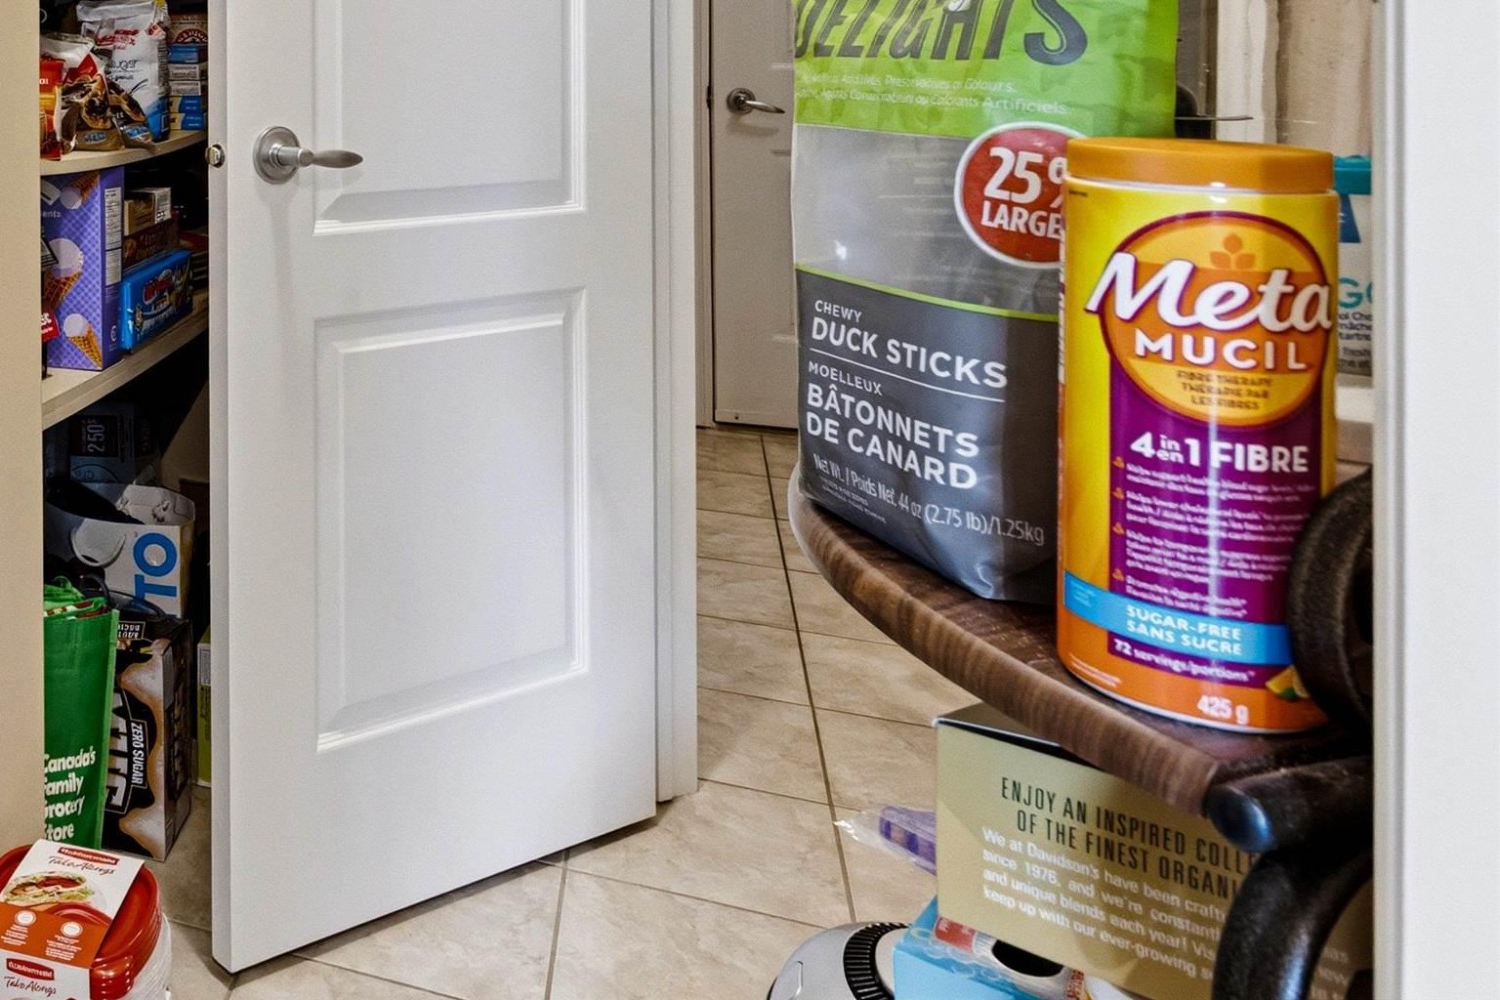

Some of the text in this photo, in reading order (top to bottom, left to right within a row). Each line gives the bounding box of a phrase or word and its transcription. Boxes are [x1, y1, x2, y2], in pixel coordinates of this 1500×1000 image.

[814, 299, 862, 323] CHEWY
[1084, 250, 1334, 332] Meta
[811, 316, 1008, 389] DUCK STICKS
[1134, 328, 1308, 370] MUCIL
[808, 360, 883, 396] MOELLEUX
[1176, 370, 1275, 387] FIBRE THERAPY
[806, 383, 980, 459] BÂTONNETS
[1190, 395, 1260, 411] LES FIBRES
[806, 411, 978, 490] DE CANARD
[1130, 431, 1309, 473] 4 in 1 FIBRE
[1156, 448, 1184, 464] en
[851, 470, 877, 498] Poids
[911, 501, 922, 519] oz
[924, 502, 962, 528] (2.75
[1126, 604, 1243, 641] SUGAR-FREE
[1126, 620, 1243, 656] SANS SUCRE
[1114, 638, 1132, 657] 72
[1197, 695, 1249, 725] 425 g
[131, 722, 143, 785] ZERO SUGAR
[44, 772, 84, 795] amily
[44, 823, 75, 842] tore
[1001, 776, 1186, 856] ENJOY AN INSPIRED
[1017, 809, 1150, 874] OF THE FINEST
[982, 849, 1143, 916] since and we're
[983, 827, 1181, 908] We at Davidson's have been
[983, 868, 1188, 952] and unique blends each year!
[982, 886, 1197, 978] keep up with our ever-growing
